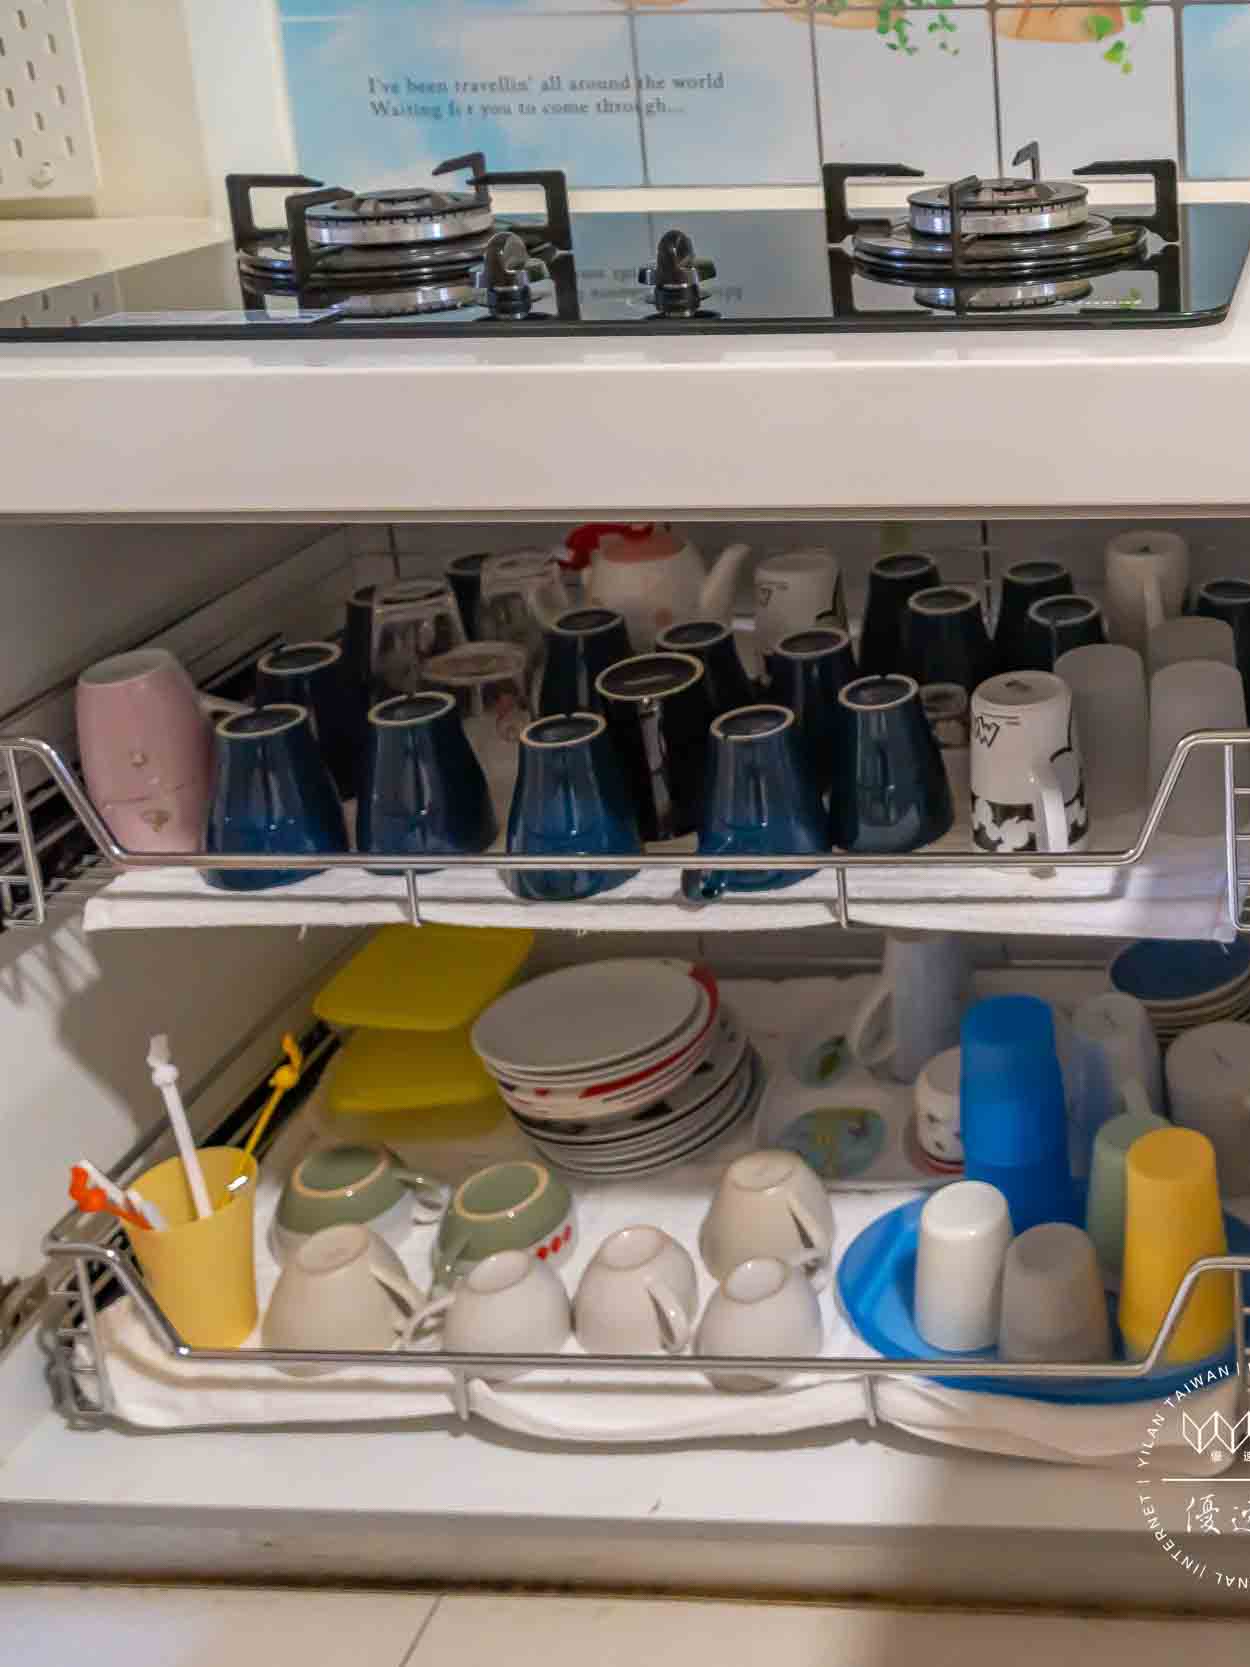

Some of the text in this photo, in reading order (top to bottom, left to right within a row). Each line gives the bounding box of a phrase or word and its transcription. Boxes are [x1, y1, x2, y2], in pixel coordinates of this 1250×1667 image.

[368, 74, 399, 95] I've
[406, 73, 448, 94] been
[541, 74, 561, 91] all
[569, 73, 631, 91] around
[672, 72, 725, 90] world
[369, 100, 443, 120] Waiting
[481, 103, 512, 120] you
[518, 102, 537, 114] to
[542, 102, 590, 114] come
